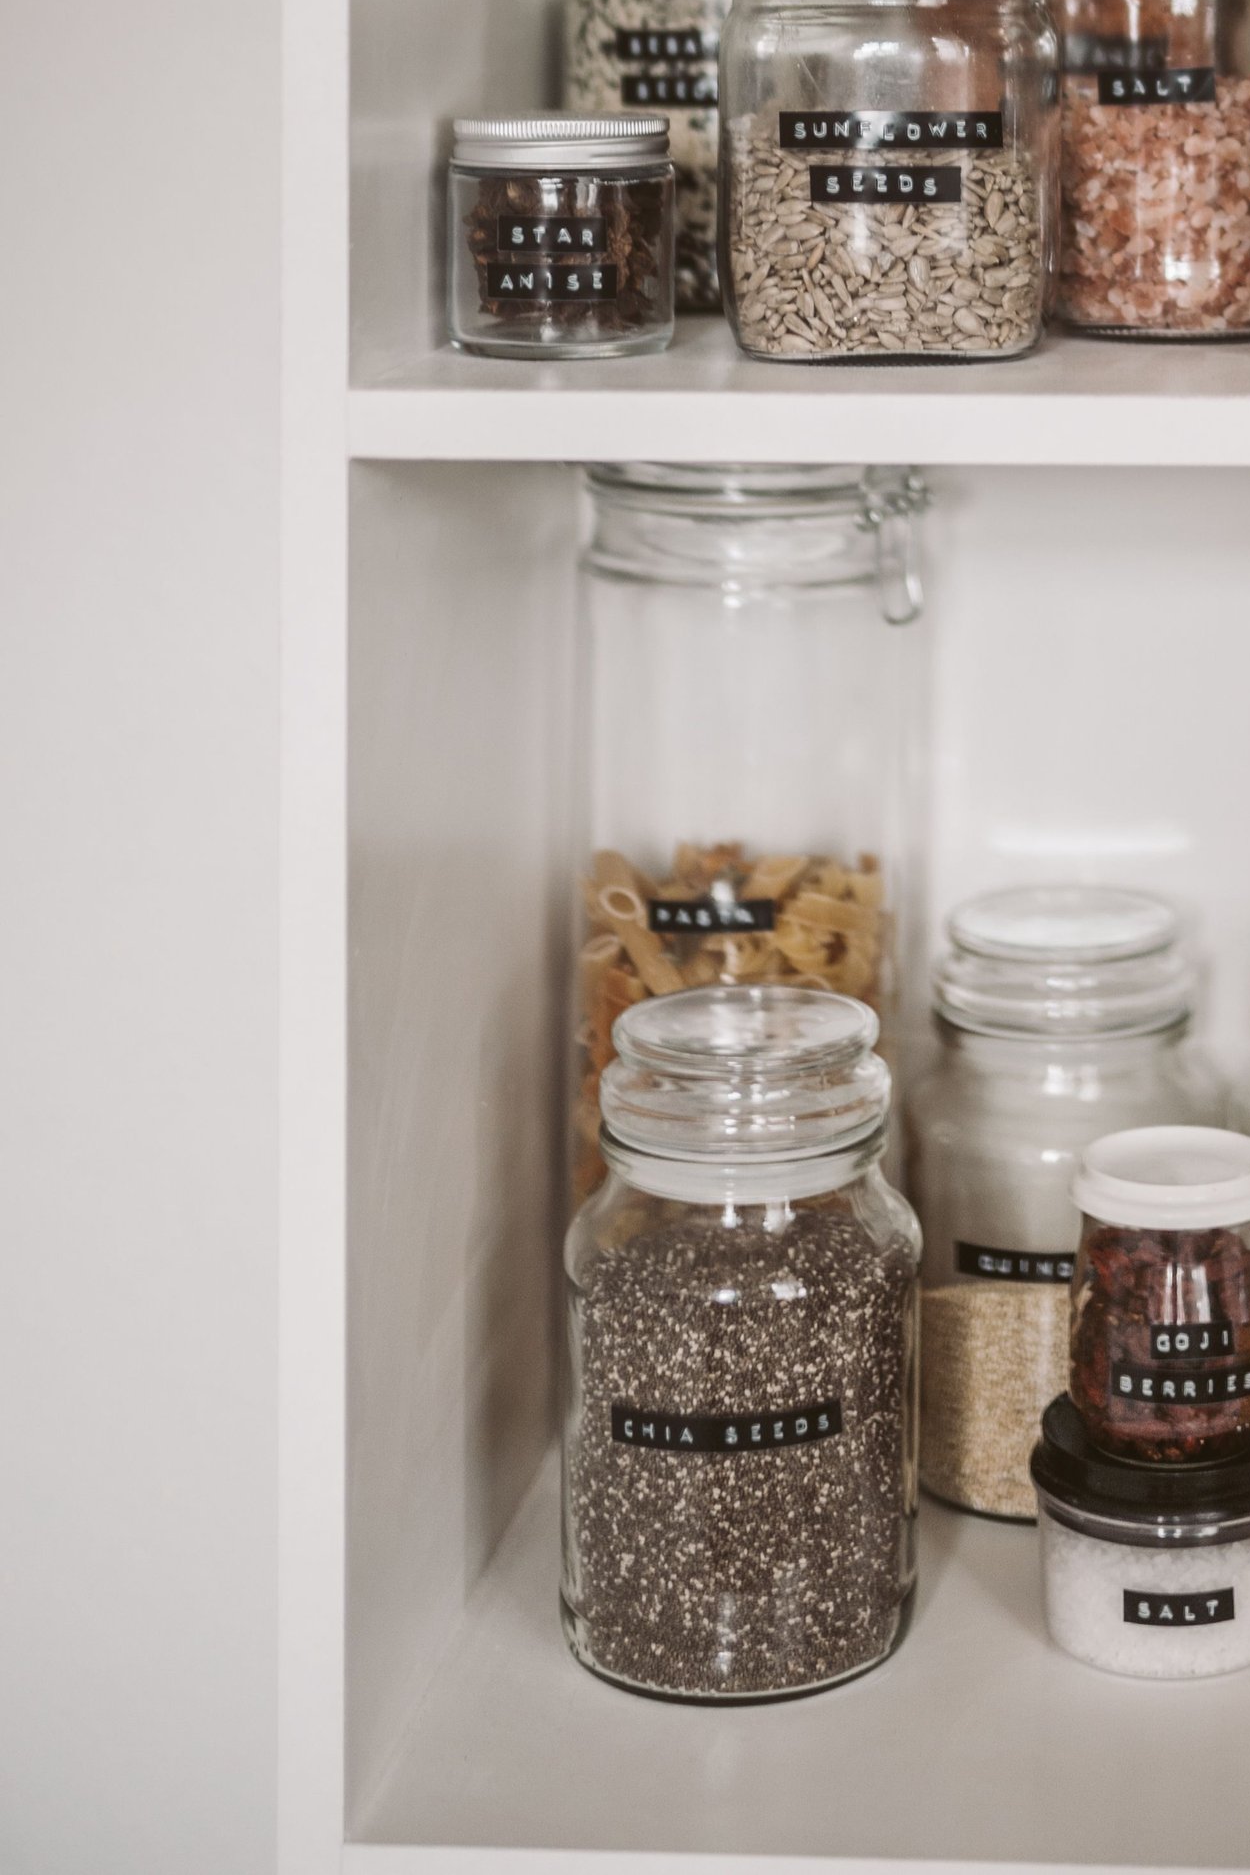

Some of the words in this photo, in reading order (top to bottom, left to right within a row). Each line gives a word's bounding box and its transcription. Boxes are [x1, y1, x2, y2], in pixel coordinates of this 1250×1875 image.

[1112, 75, 1192, 97] SALT
[794, 119, 988, 141] SUNFLOWER
[826, 172, 937, 196] SEEDS
[511, 226, 594, 247] STAR
[500, 271, 603, 292] ANISE
[977, 1254, 1074, 1278] QUINO
[1156, 1330, 1229, 1352] GOJI
[624, 1420, 694, 1444] CHIA
[725, 1414, 830, 1445] SEEDS
[1137, 1600, 1219, 1621] SALT
